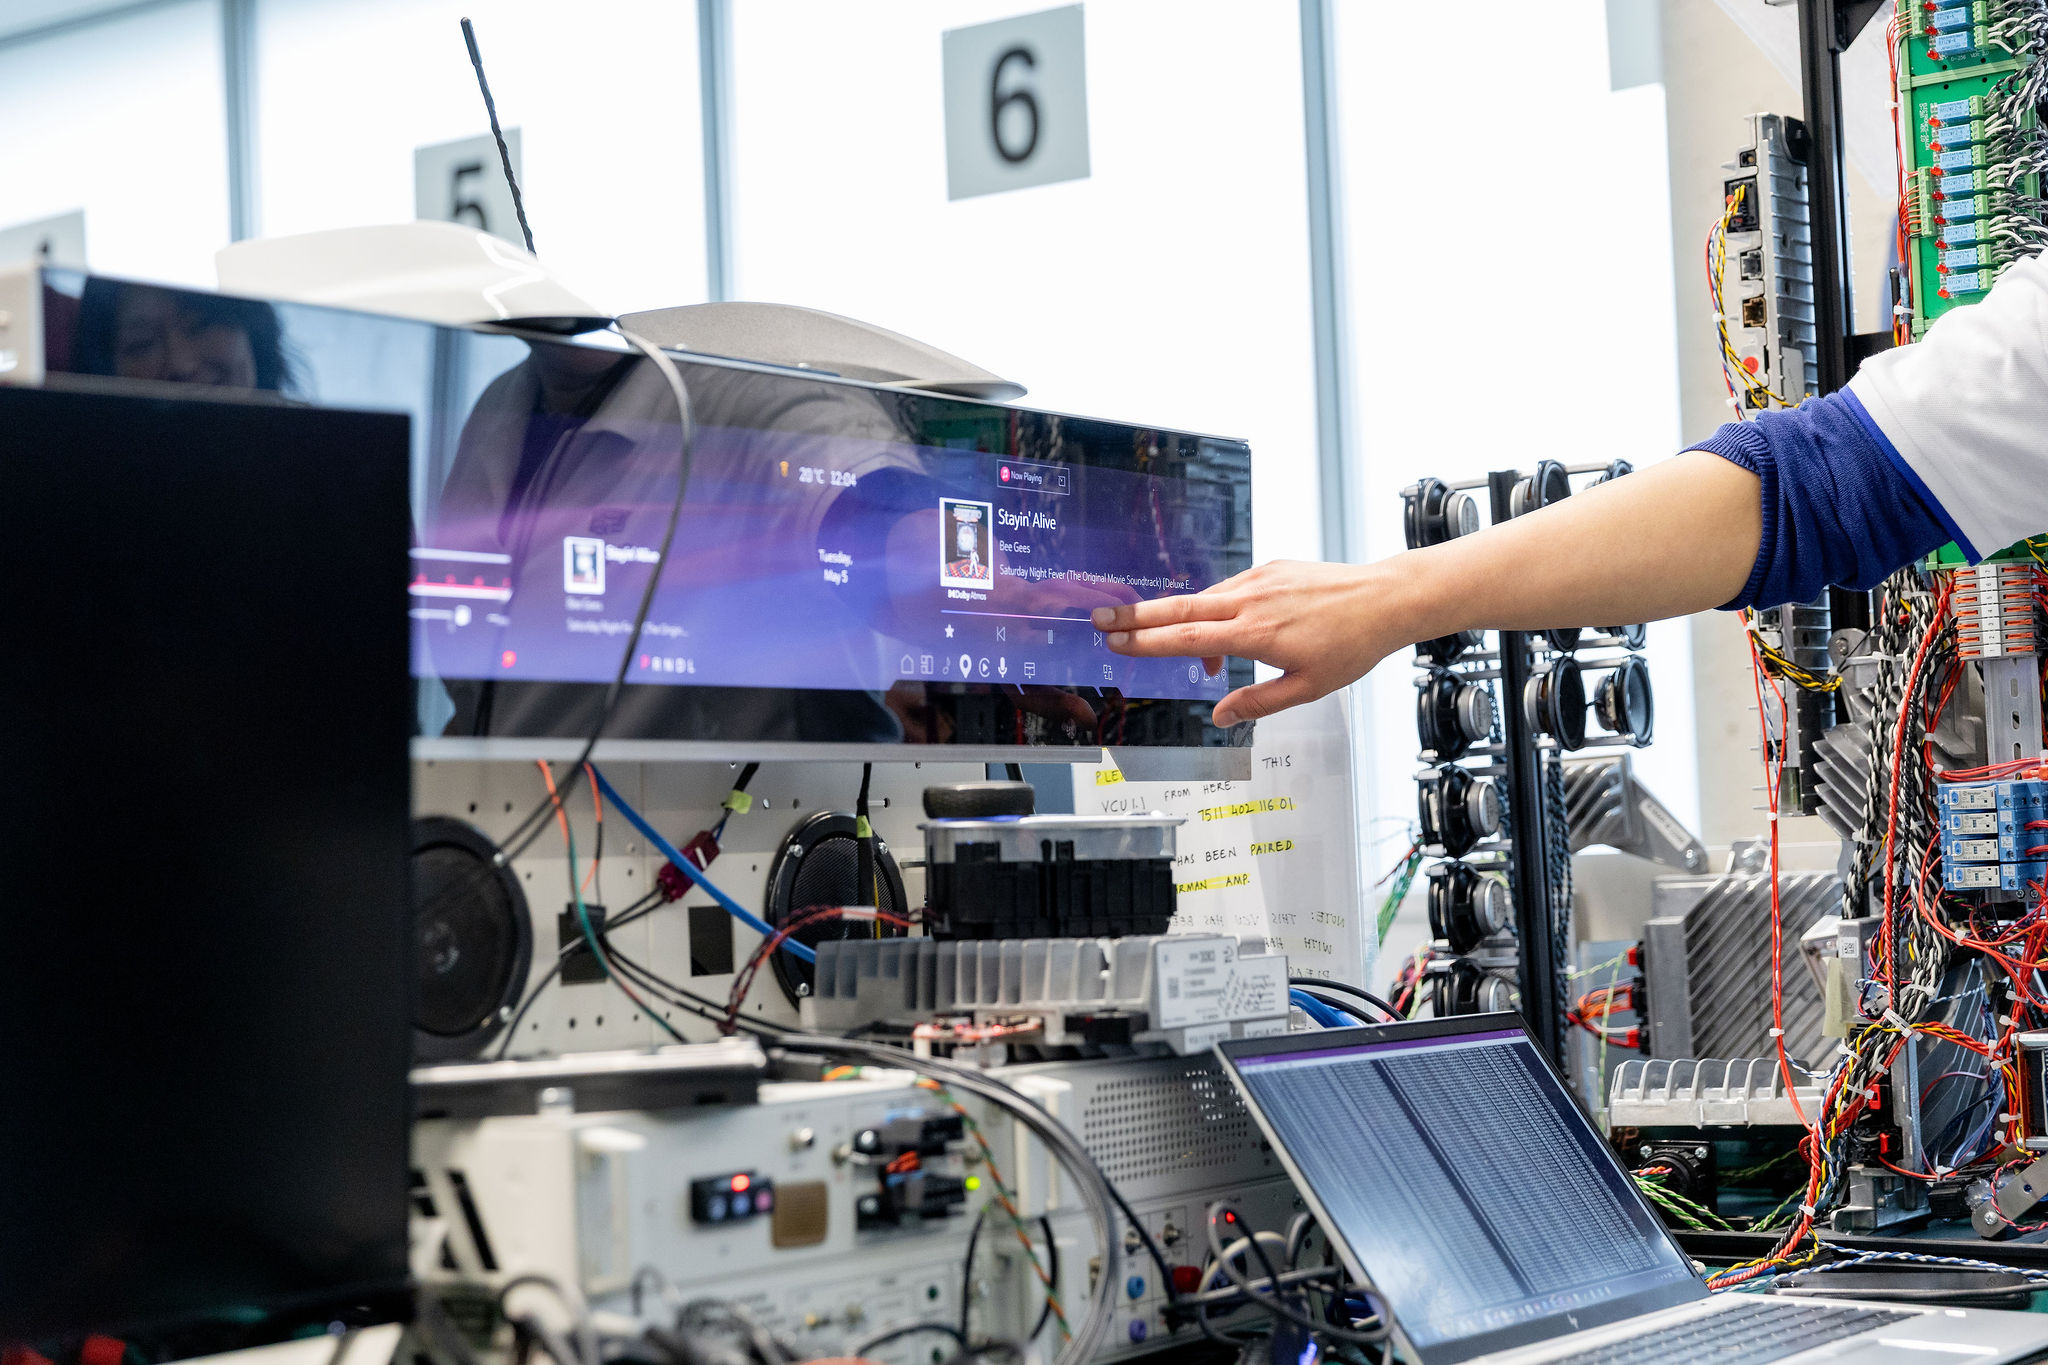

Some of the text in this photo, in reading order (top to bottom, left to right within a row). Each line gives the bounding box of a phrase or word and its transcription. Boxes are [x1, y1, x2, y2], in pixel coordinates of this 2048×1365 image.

[990, 46, 1040, 166] 6
[452, 162, 489, 231] 5
[1011, 470, 1043, 484] Now Playing
[998, 508, 1031, 531] Stayin'
[1032, 511, 1057, 530] Alive
[818, 548, 853, 567] Tuesday,
[999, 540, 1031, 554] Bee Gees
[823, 568, 849, 585] May 5
[999, 564, 1028, 580] Saturday
[1029, 566, 1047, 581] Night
[1048, 568, 1066, 580] Fever
[1066, 569, 1081, 583] (The
[1082, 570, 1106, 585] Original
[1107, 573, 1126, 585] Movie
[1126, 575, 1161, 590] Soundtrack)
[1096, 755, 1292, 784] PLE THIS
[1164, 788, 1191, 801] FROM
[1197, 805, 1224, 822] 7511
[1231, 801, 1254, 816] 402
[1259, 798, 1274, 812] 116
[1279, 797, 1294, 811] 01
[1177, 840, 1293, 866] HAS BEEN PAIRED
[1226, 873, 1251, 888] AMP.
